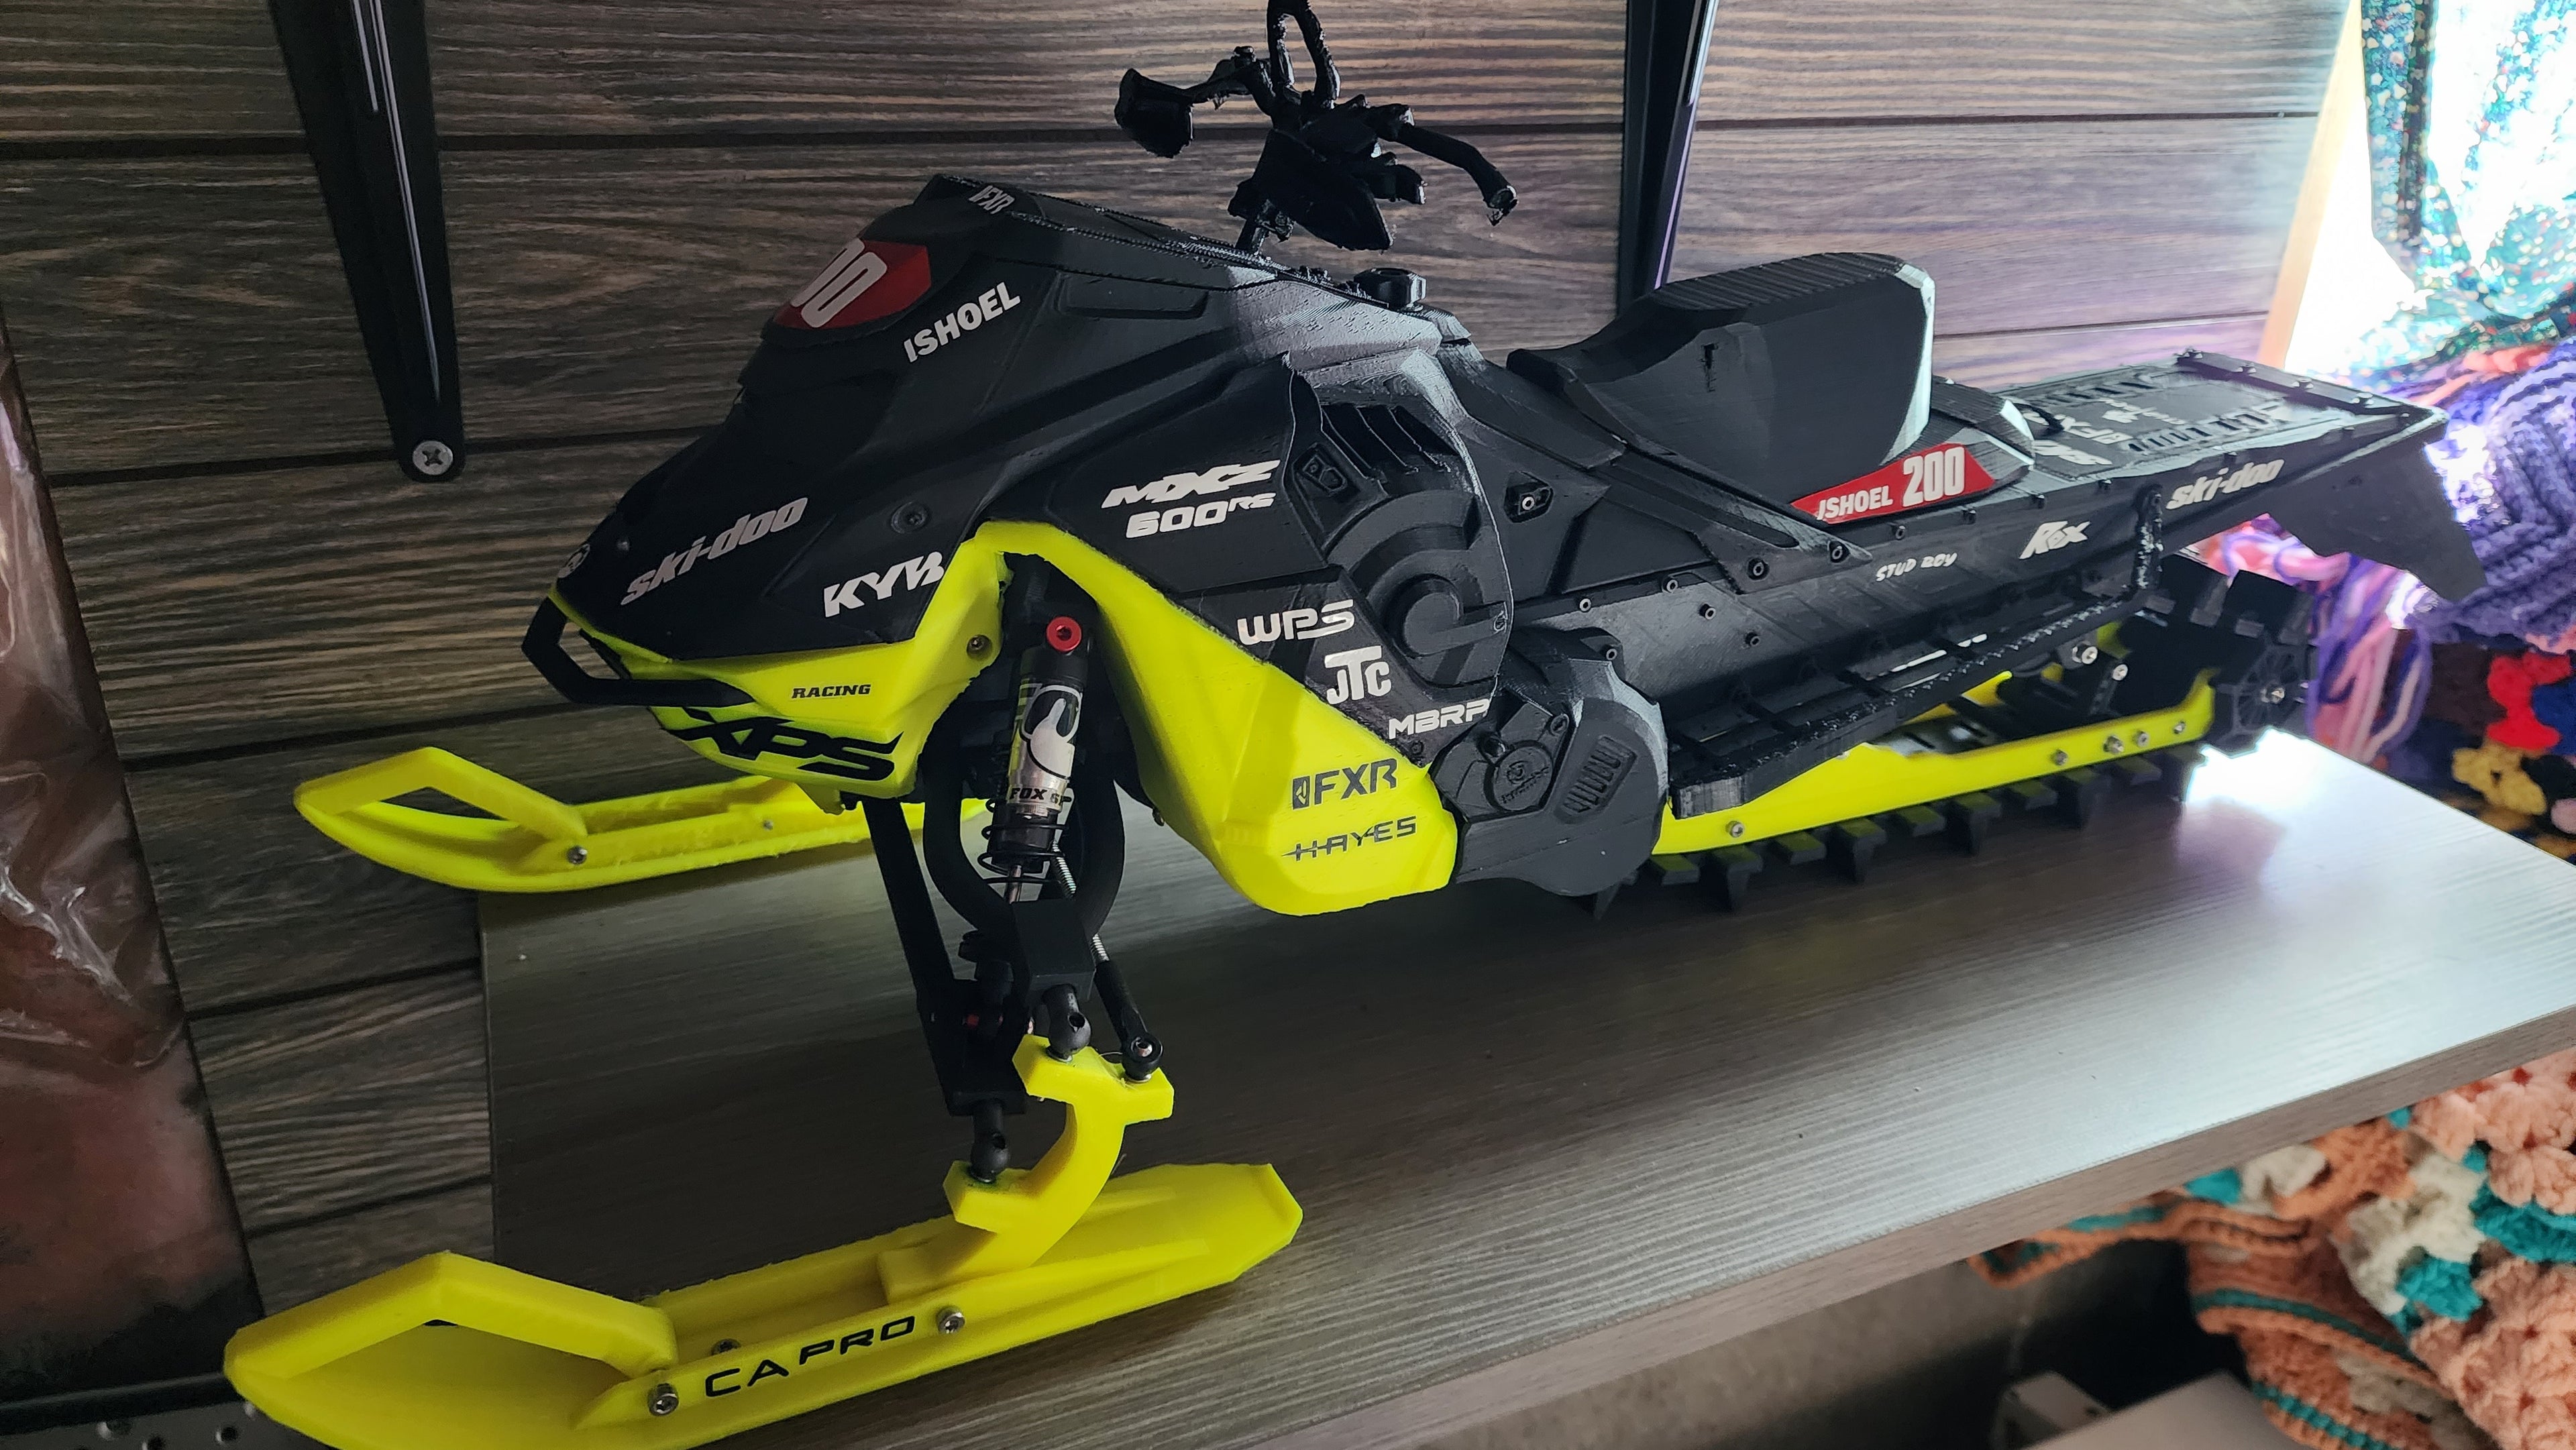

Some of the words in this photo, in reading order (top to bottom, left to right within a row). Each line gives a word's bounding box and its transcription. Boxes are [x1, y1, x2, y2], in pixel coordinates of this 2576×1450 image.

[904, 282, 1022, 363] ISHOEL
[1902, 447, 1965, 507] 200
[823, 551, 945, 618] KYB
[1876, 558, 1917, 582] STUD
[1921, 552, 1957, 568] BOY
[1237, 599, 1355, 645] WPS
[791, 684, 871, 700] RACING
[1389, 698, 1491, 740] MBRP
[1009, 787, 1047, 800] FOX
[1313, 758, 1397, 805] FXR
[1281, 816, 1416, 861] HAYES
